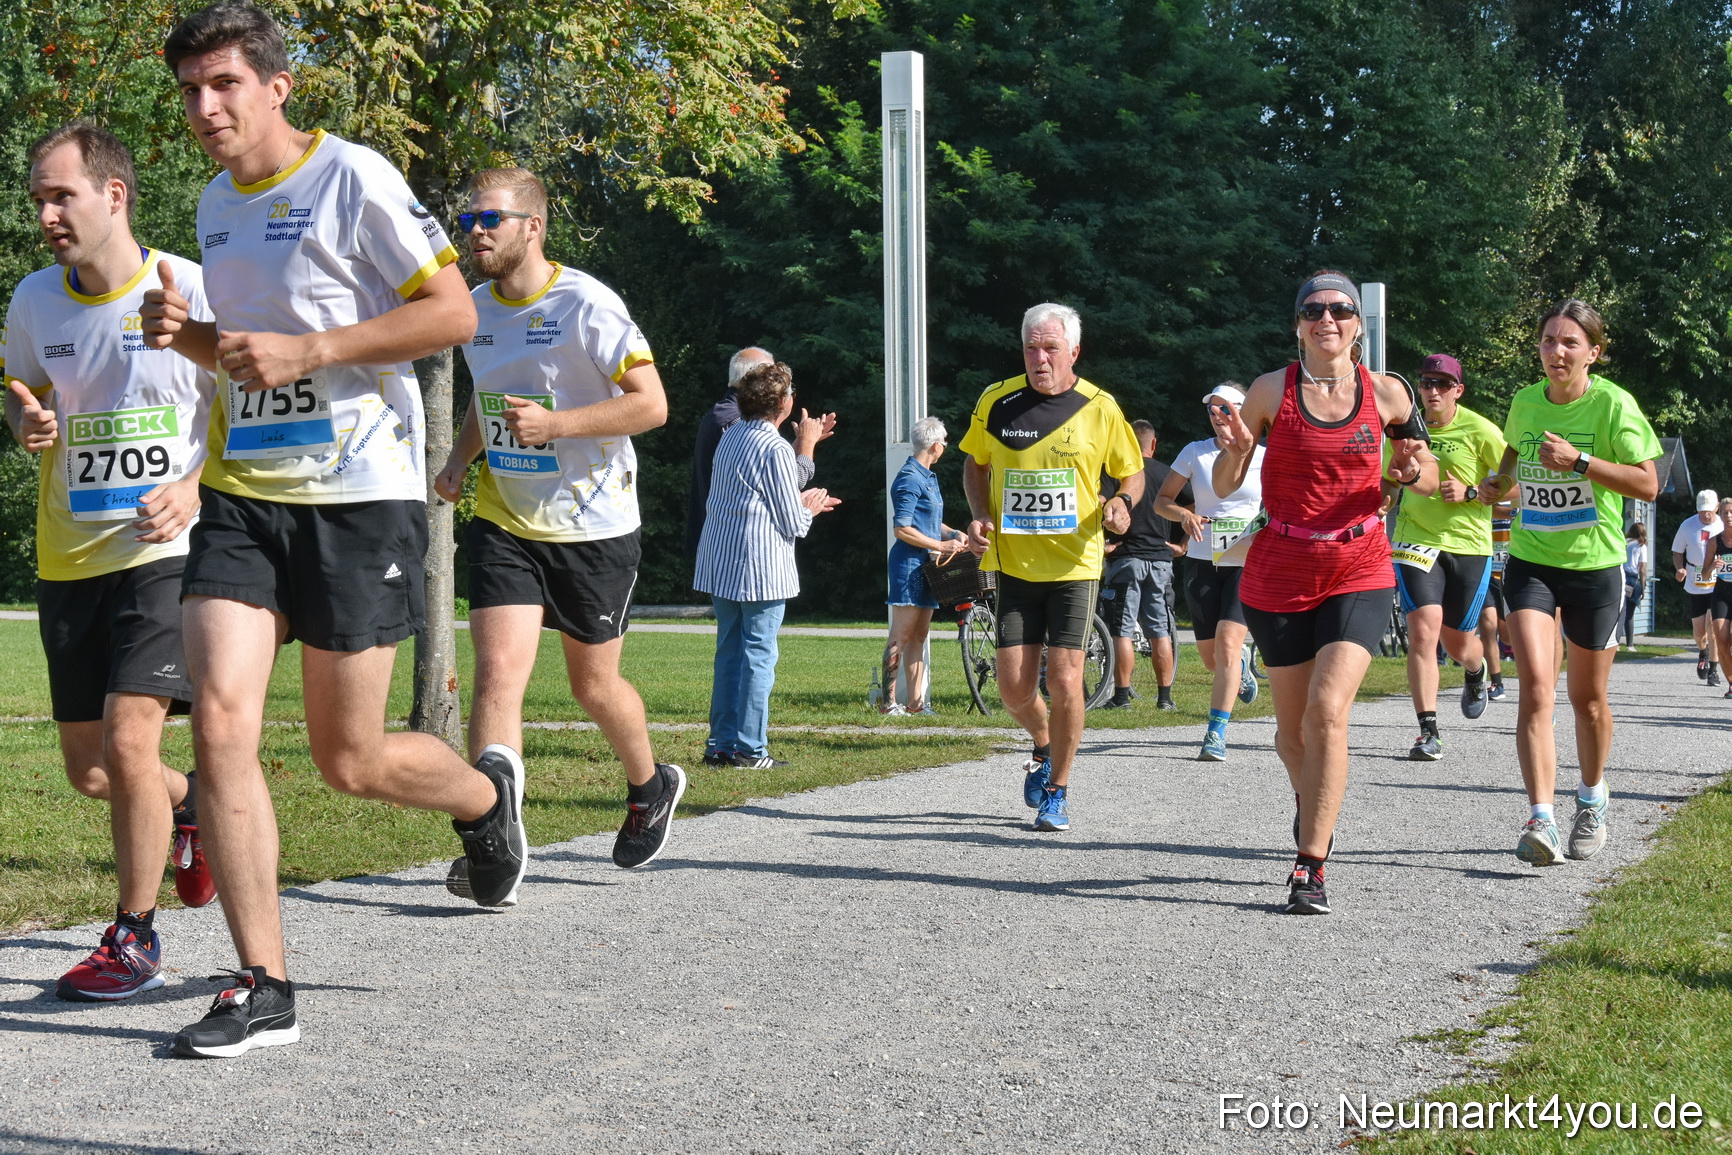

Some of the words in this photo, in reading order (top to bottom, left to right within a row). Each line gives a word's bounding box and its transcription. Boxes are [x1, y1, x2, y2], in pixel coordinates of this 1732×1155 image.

[270, 203, 289, 219] 20
[266, 220, 315, 230] Neumarkter
[265, 231, 303, 241] Stadtlauf
[528, 317, 545, 328] 20
[44, 344, 75, 355] BOCK
[238, 378, 316, 419] 2755
[73, 410, 169, 442] BOCK
[352, 419, 382, 455] September
[380, 404, 395, 421] 2019
[1001, 428, 1038, 438] Norbert
[491, 421, 547, 450] 21
[1050, 446, 1080, 457] Burgthann
[1342, 444, 1378, 454] adidas
[78, 445, 170, 483] 2709
[499, 456, 538, 470] TOBIAS
[1009, 471, 1069, 487] BOCK
[1011, 492, 1066, 512] 2291
[1526, 485, 1584, 508] 2802
[1013, 518, 1066, 527] NORBERT
[1531, 511, 1589, 523] CHRISTINE
[1391, 551, 1428, 565] CHRISTIAN
